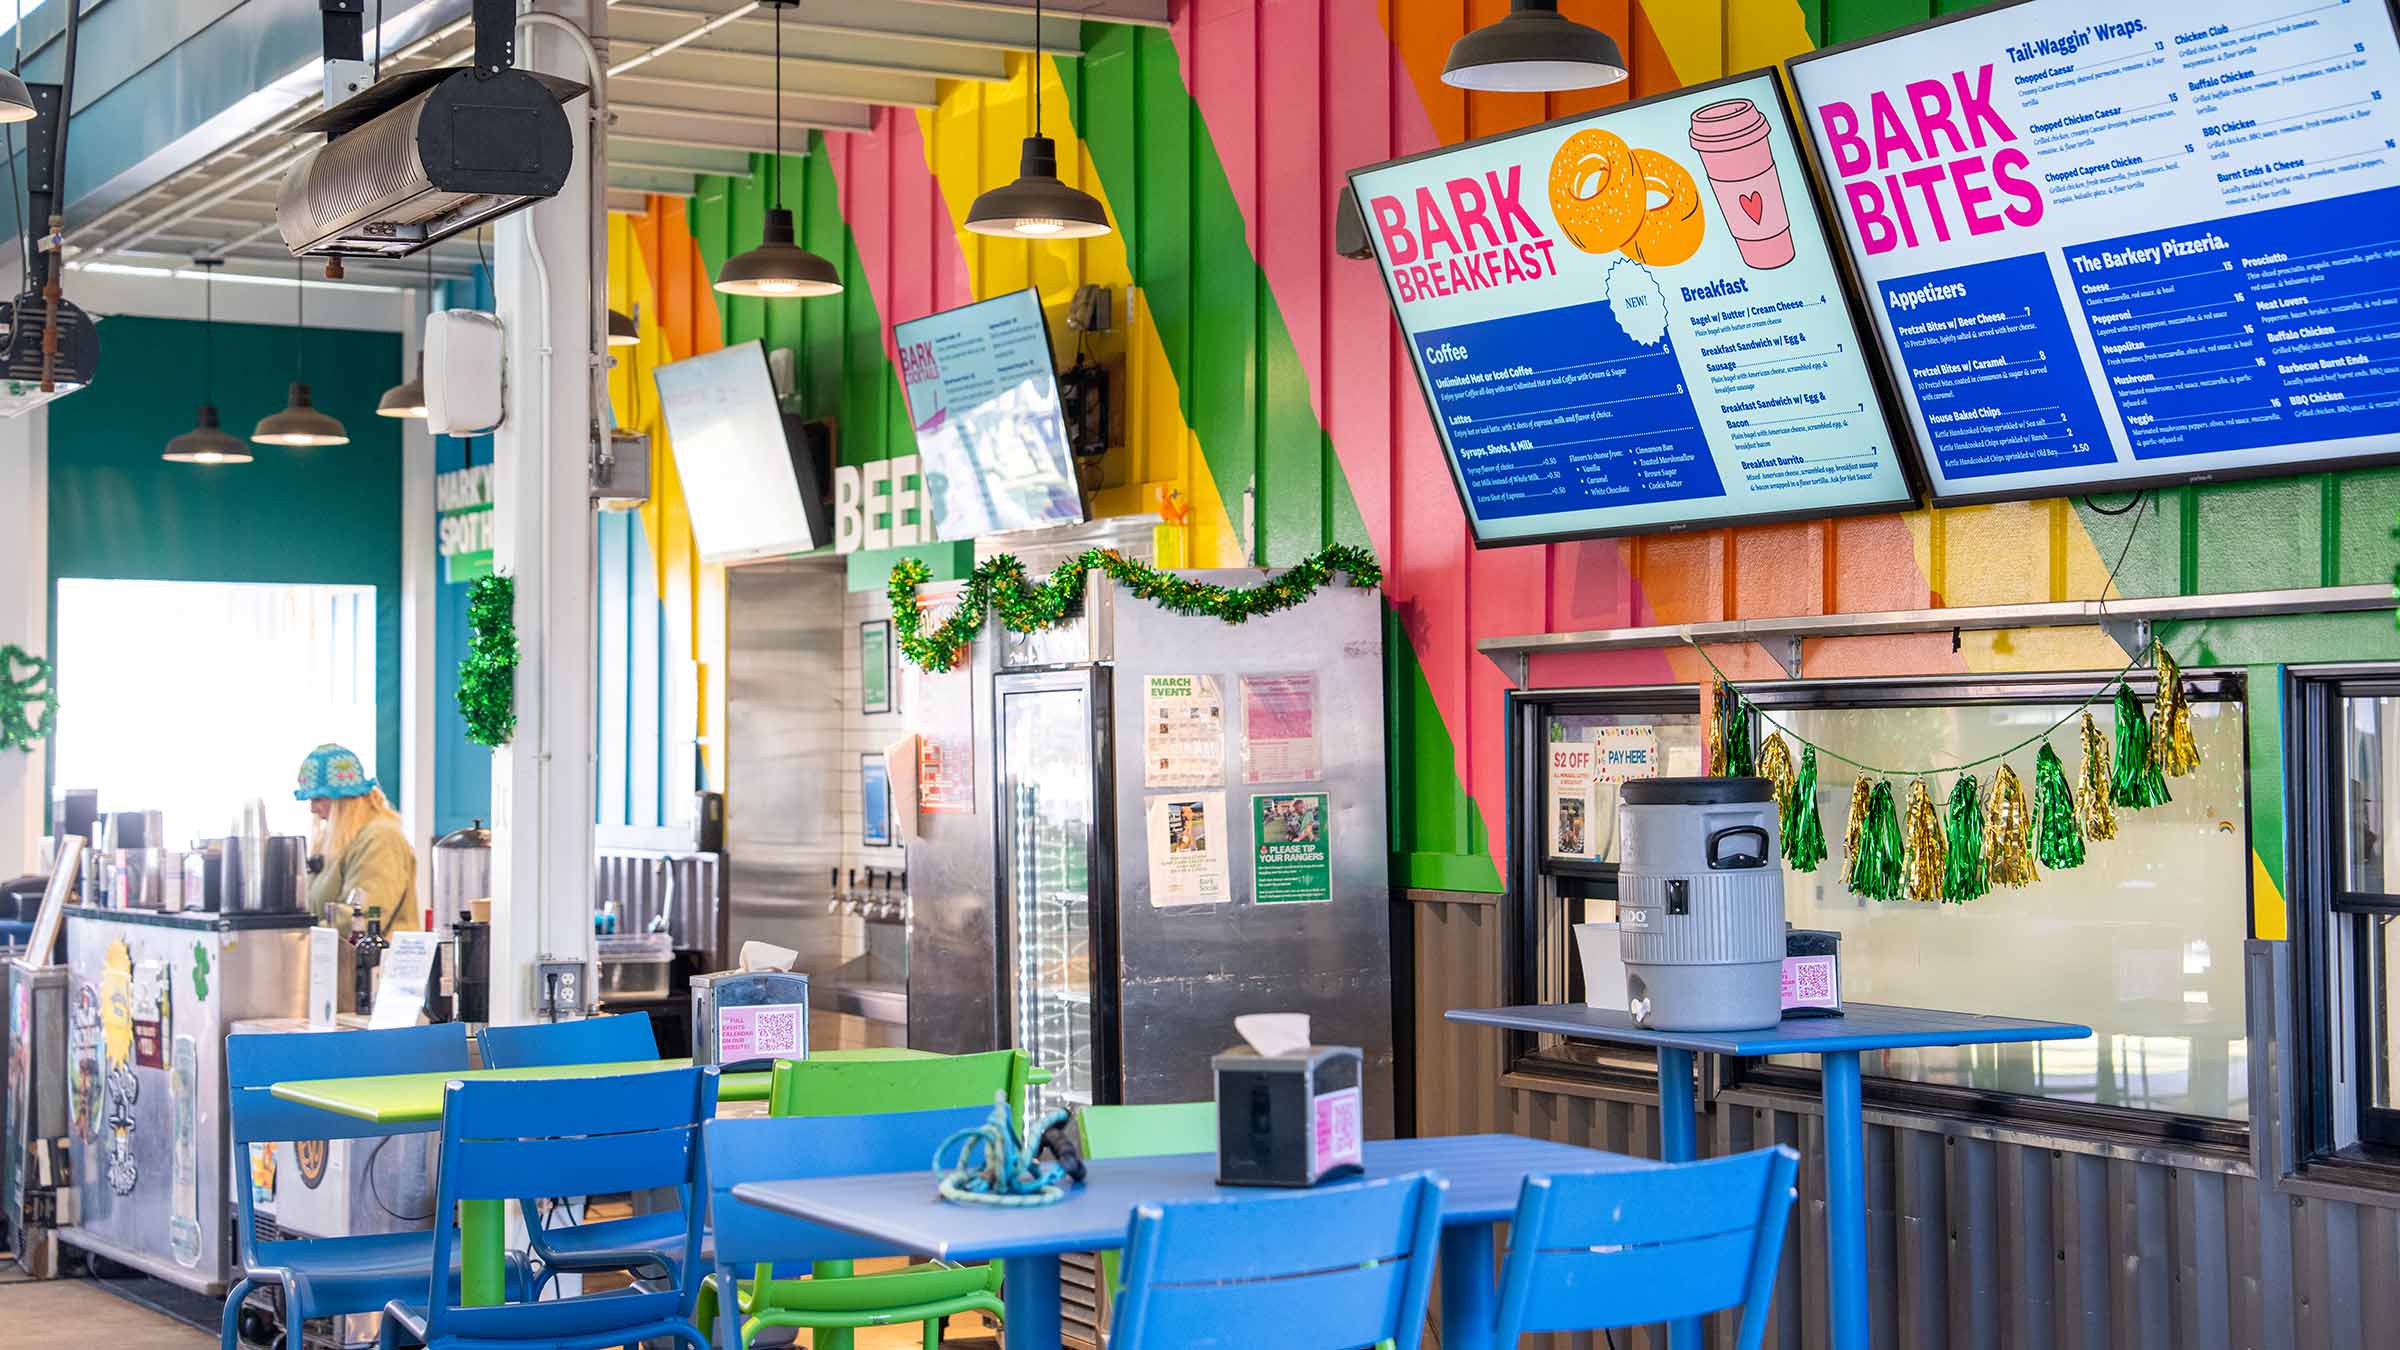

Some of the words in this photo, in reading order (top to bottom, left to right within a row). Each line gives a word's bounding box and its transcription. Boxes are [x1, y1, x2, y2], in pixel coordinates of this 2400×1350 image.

[2006, 27, 2091, 62] Tail-Waggin'
[2093, 19, 2148, 41] Wraps.
[2174, 31, 2208, 45] Chicken
[2208, 24, 2228, 36] Club
[2014, 69, 2048, 85] Chopped
[2048, 64, 2073, 77] Caesar
[2155, 41, 2165, 51] 13
[2188, 77, 2219, 91] Buffalo
[2220, 70, 2255, 84] Chicken
[2353, 42, 2365, 53] 15
[1818, 64, 2018, 178] BARK
[2029, 118, 2063, 133] Chopped
[2063, 113, 2094, 126] Chicken
[2094, 107, 2120, 119] Caesar
[2168, 92, 2178, 102] 15
[2202, 125, 2221, 137] BBQ
[2221, 119, 2256, 132] Chicken
[2044, 167, 2078, 182] Chopped
[2078, 163, 2110, 176] Caprese
[2110, 156, 2142, 168] Chicken
[2185, 144, 2194, 153] 15
[2216, 170, 2242, 182] Burnt
[2242, 166, 2264, 177] Ends
[2264, 164, 2272, 173] &
[2273, 159, 2304, 171] Cheese
[1844, 147, 2044, 256] BITES
[1370, 165, 1543, 267] BARK
[2072, 254, 2104, 272] The
[2102, 247, 2160, 268] Barkery
[2161, 232, 2229, 257] Pizzeria.
[2241, 252, 2288, 268] Prosciutto
[1393, 239, 1559, 303] BREAKFAST
[2081, 282, 2109, 294] Cheese
[2222, 261, 2233, 271] 15
[1625, 295, 1648, 309] NEW!
[1680, 277, 1749, 302] Breakfast
[1889, 282, 1967, 311] Appetizers
[1690, 314, 1711, 326] Bagel
[1710, 312, 1720, 322] w/
[1721, 310, 1745, 320] Butter
[1746, 307, 1751, 318] /
[1750, 305, 1776, 315] Cream
[1776, 300, 1803, 311] Cheese
[1820, 295, 1826, 304] 4
[2092, 309, 2132, 325] Pepperoni
[2234, 292, 2245, 303] 16
[2255, 299, 2279, 310] Meat
[2278, 296, 2309, 307] Lovers
[1898, 322, 1927, 336] Pretzel
[1925, 321, 1947, 332] Bites
[1946, 317, 1957, 329] w/
[1957, 317, 1976, 327] Beer
[1976, 312, 2006, 324] Cheese
[2024, 306, 2031, 316] 7
[2266, 329, 2299, 342] Buffalo
[2299, 325, 2336, 337] Chicken
[1700, 344, 1736, 356] Breakfast
[1736, 337, 1772, 351] Sandwich
[1772, 335, 1782, 346] w/
[1783, 335, 1799, 346] Egg
[1798, 332, 1806, 341] &
[2102, 341, 2145, 355] Neapolitan
[2243, 324, 2254, 335] 16
[900, 341, 936, 371] BARK
[1426, 343, 1468, 364] Coffee
[1435, 374, 1471, 388] Unlimited
[1469, 373, 1484, 383] Hot
[1484, 373, 1492, 381] or
[1492, 368, 1509, 380] Iced
[1508, 365, 1533, 377] Coffee
[1663, 344, 1670, 354] 6
[1706, 361, 1737, 372] Sausage
[1837, 343, 1843, 352] 7
[1912, 364, 1941, 377] Pretzel
[1940, 363, 1961, 374] Bites
[1960, 360, 1972, 372] w/
[1972, 355, 2007, 369] Caramel
[2039, 350, 2046, 360] 8
[2277, 362, 2319, 374] Barbecue
[2318, 357, 2346, 368] Burnt
[2344, 353, 2369, 365] Ends
[2113, 372, 2154, 385] Mushroom
[2255, 357, 2266, 367] 16
[1448, 415, 1472, 425] Lattes
[1676, 383, 1683, 394] 8
[1720, 401, 1757, 413] Breakfast
[1756, 395, 1792, 408] Sandwich
[1792, 394, 1802, 404] w/
[1803, 393, 1819, 404] Egg
[1818, 391, 1826, 400] &
[2288, 394, 2309, 406] BBQ
[2308, 391, 2344, 403] Chicken
[1726, 419, 1750, 429] Bacon
[1858, 403, 1864, 412] 7
[1928, 414, 1953, 424] House
[1952, 408, 1978, 421] Baked
[1978, 406, 2001, 418] Chips
[2060, 413, 2067, 422] 2
[2127, 413, 2154, 426] Veggie
[2270, 398, 2281, 408] 16
[2066, 428, 2073, 437] 2
[1460, 447, 1488, 459] Syrups,
[1486, 444, 1511, 454] Shots,
[1516, 439, 1534, 450] Milk
[1741, 458, 1777, 470] Breakfast
[1776, 455, 1804, 466] Burrito
[1872, 446, 1877, 455] 7
[2072, 443, 2090, 453] 2.50
[1151, 678, 1191, 686] MARCH
[1151, 688, 1192, 697] EVENTS
[1569, 752, 1590, 768] OFF
[1608, 751, 1625, 764] PAY
[1625, 750, 1647, 763] HERE
[1260, 854, 1284, 863] YOUR
[1285, 853, 1325, 862] RANGERS
[1269, 846, 1301, 855] PLEASE
[1301, 845, 1316, 854] TIP
